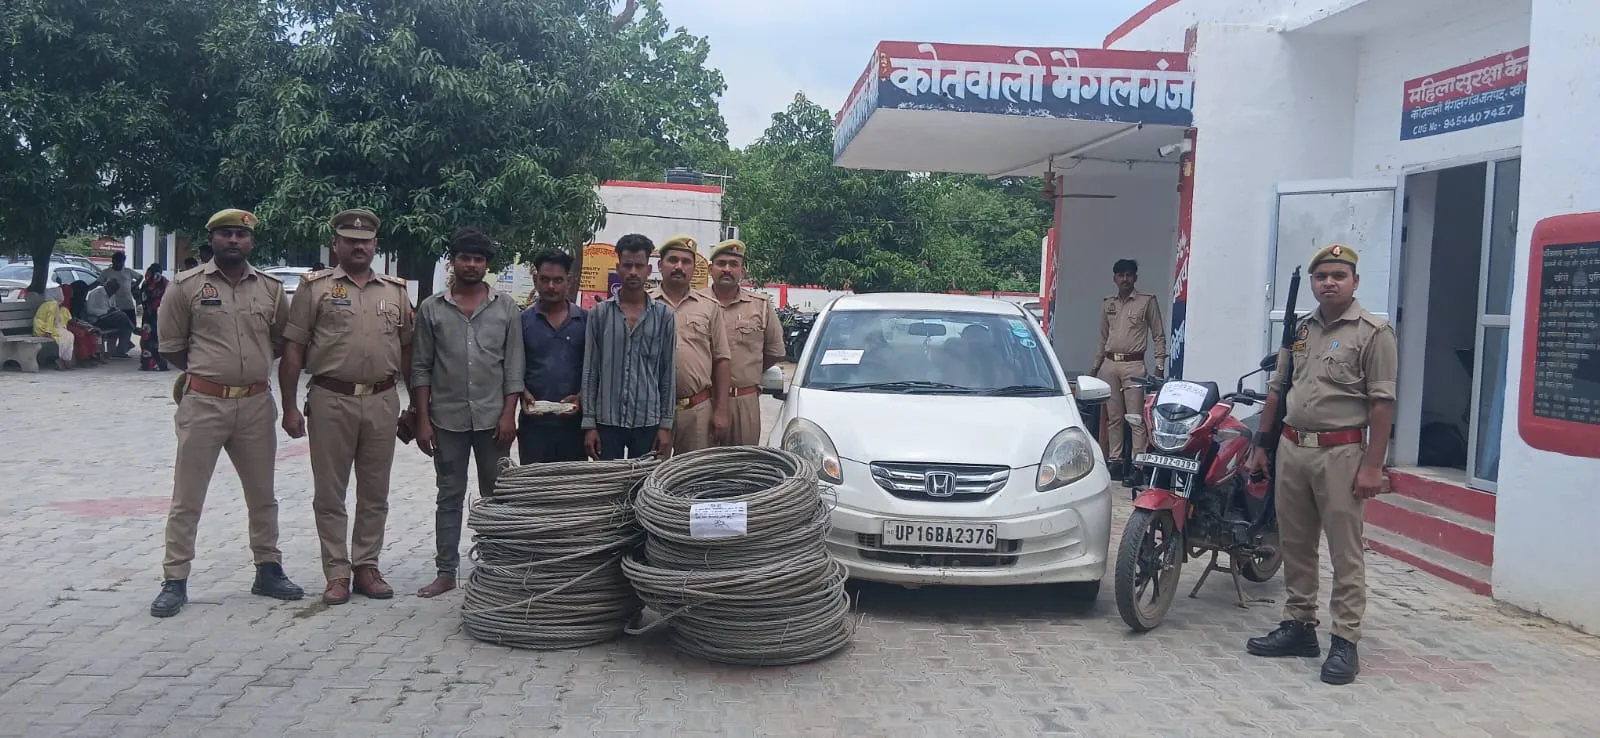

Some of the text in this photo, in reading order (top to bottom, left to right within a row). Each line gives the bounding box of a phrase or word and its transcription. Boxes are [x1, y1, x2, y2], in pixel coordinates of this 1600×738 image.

[890, 43, 1044, 103] कोतवाली
[1050, 49, 1194, 110] मैगलगंज
[1407, 77, 1456, 103] महिला
[1455, 63, 1504, 95] सुरक्षा
[895, 524, 995, 545] UP16BA2376
